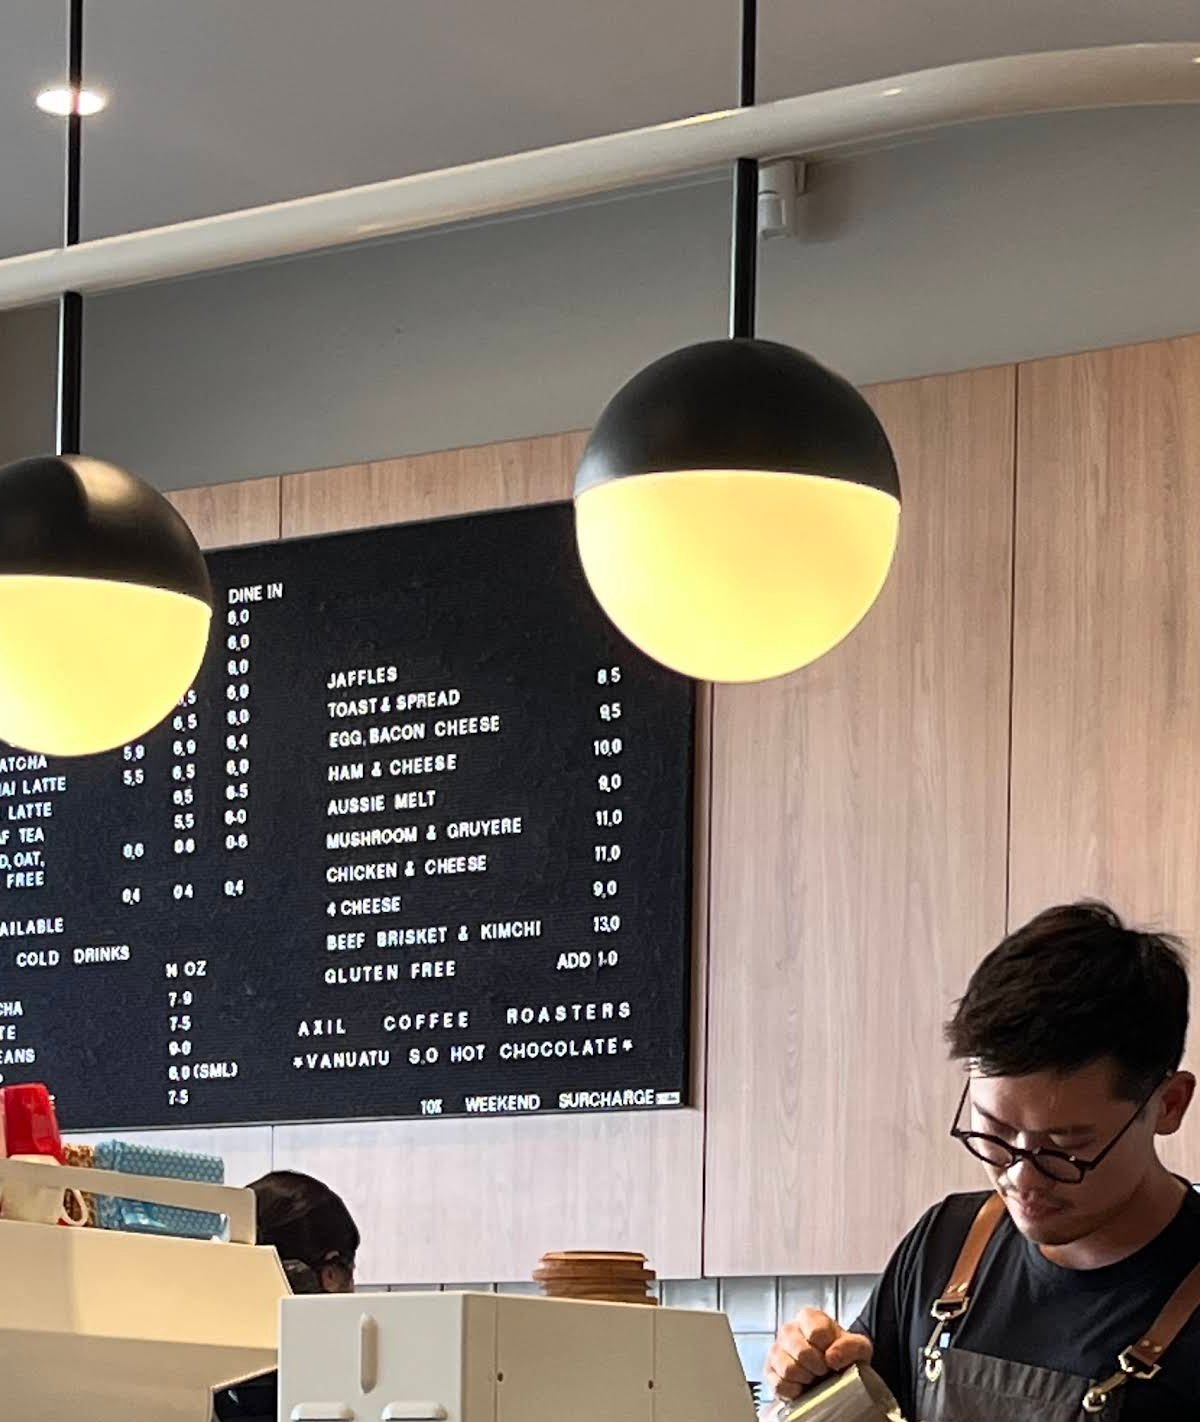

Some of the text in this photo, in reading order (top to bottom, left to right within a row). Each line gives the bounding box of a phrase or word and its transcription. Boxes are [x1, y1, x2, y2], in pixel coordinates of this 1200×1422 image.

[228, 582, 283, 605] DINE IN
[227, 633, 250, 652] 6.0
[326, 665, 398, 690] JAFFLES
[226, 683, 250, 702] 6.0
[327, 688, 461, 718] TOAST & SPREAD
[172, 713, 198, 732] 6.5
[226, 708, 250, 726] 6.0
[369, 722, 426, 744] BACON
[434, 714, 500, 737] CHEESE
[593, 738, 623, 757] 10.0
[123, 768, 144, 787] 5.5
[172, 763, 196, 782] 6.5
[225, 758, 250, 777] 6.0
[327, 753, 457, 782] HAM & CHEESE
[0, 775, 67, 798] AI LATTE
[8, 801, 53, 821] LATTE
[327, 789, 436, 816] AUSSIE MELT
[595, 808, 623, 827] 11.0
[18, 826, 45, 844] TEA
[326, 816, 522, 850] MUSHROOM & GRUYERE
[594, 844, 621, 862] 11.0
[326, 854, 487, 883] CHICKEN & CHEESE
[6, 870, 45, 889] FREE
[326, 895, 402, 918] 4 CHEESE
[0, 916, 64, 938] AILABLE
[326, 920, 542, 951] BEEF BRISKET & KIMCHI
[15, 944, 130, 968] COLD DRINKS
[556, 951, 592, 971] ADD
[183, 960, 207, 977] OZ
[324, 960, 456, 984] GLUTEN FREE
[297, 1001, 631, 1037] AXIL COFFEE ROASTERS
[450, 1044, 486, 1063] HOT
[192, 1061, 238, 1079] (SML)
[464, 1093, 544, 1114] WEEKEND
[558, 1088, 655, 1109] SURCHARGE
